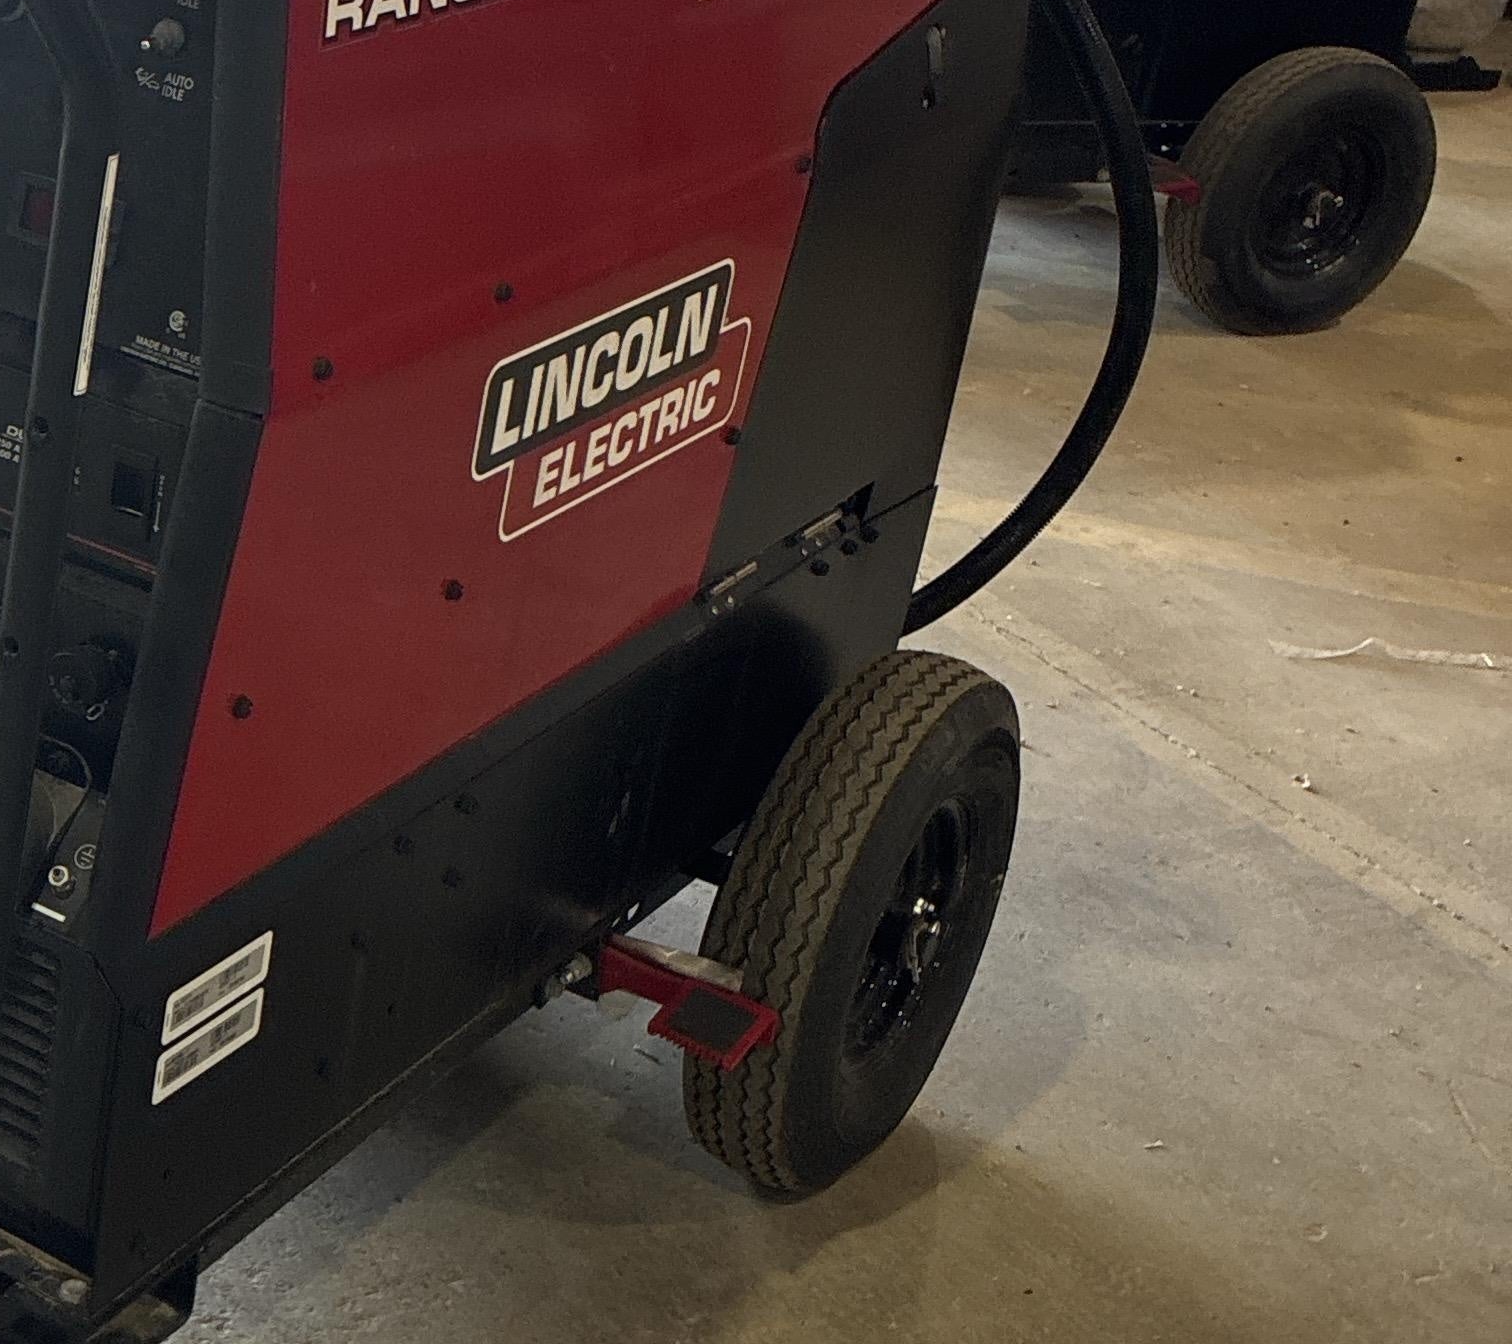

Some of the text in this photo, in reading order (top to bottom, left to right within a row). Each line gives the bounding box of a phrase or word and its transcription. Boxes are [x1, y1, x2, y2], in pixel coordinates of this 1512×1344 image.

[161, 86, 185, 102] IDLE
[164, 72, 194, 90] AUTO
[136, 335, 160, 350] MADE
[172, 347, 189, 360] THE
[189, 352, 201, 365] US
[491, 284, 719, 455] LINCOLN
[533, 368, 721, 509] ELECTRIC
